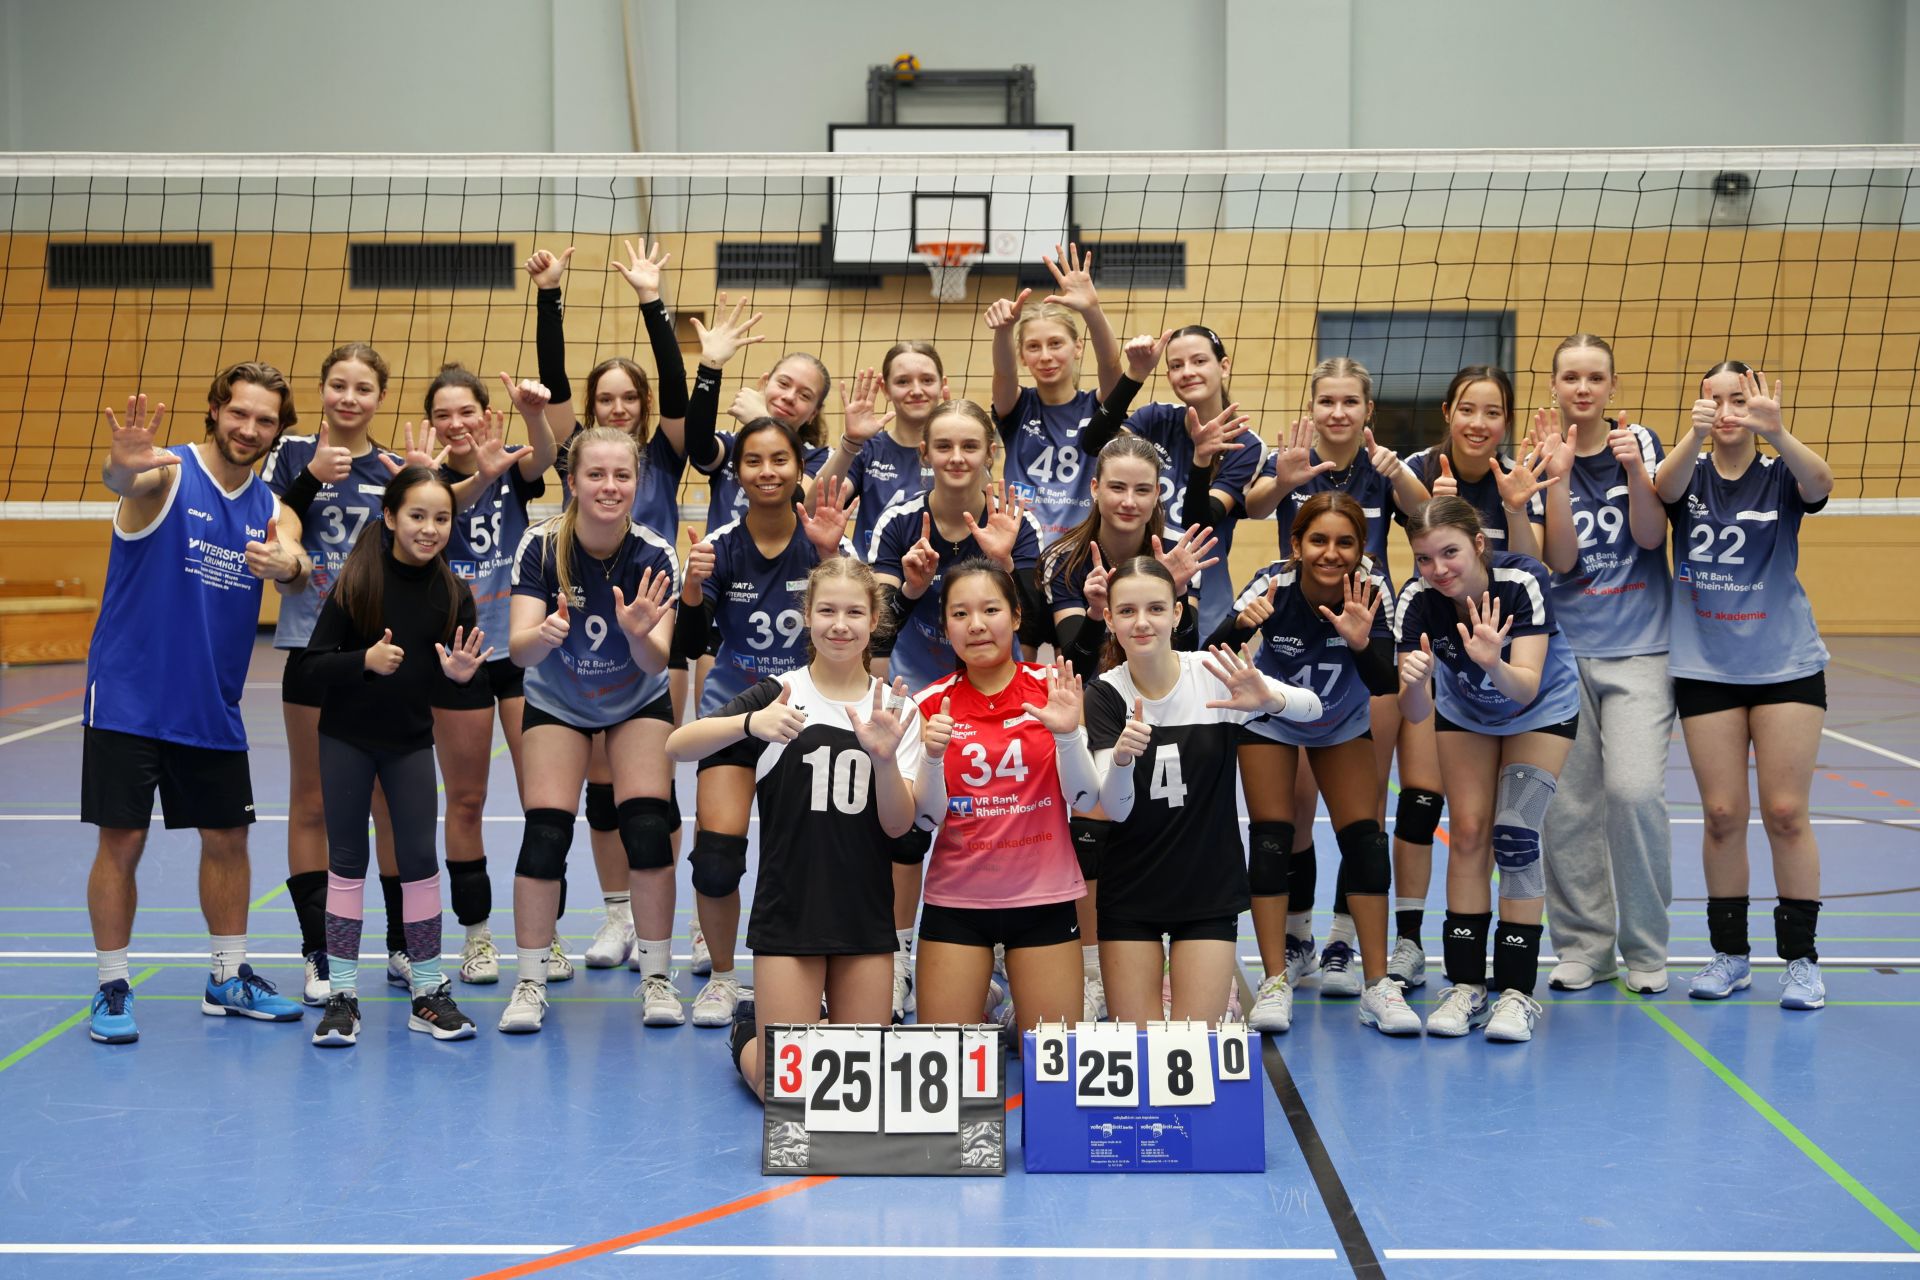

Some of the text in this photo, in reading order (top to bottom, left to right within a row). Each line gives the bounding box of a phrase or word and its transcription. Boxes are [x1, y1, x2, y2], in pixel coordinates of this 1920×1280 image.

[1027, 445, 1080, 483] 48
[1079, 498, 1090, 508] eG
[320, 505, 370, 544] 37
[1573, 505, 1624, 548] 29
[326, 551, 340, 560] VR
[1688, 523, 1746, 565] 22
[1583, 551, 1618, 566] VR Bank
[1695, 571, 1734, 582] VR Bank
[1752, 581, 1764, 591] eG
[1714, 610, 1768, 622] akademie
[584, 614, 608, 652] 9
[746, 609, 804, 651] 39
[1272, 635, 1299, 645] CRAFT
[577, 659, 615, 668] VR Bank
[757, 656, 795, 665] VR Bank
[1289, 662, 1343, 697] 47
[960, 738, 1029, 788] 34
[1150, 742, 1188, 809] 4
[802, 745, 872, 815] 10
[975, 794, 1018, 806] VR Bank
[1038, 797, 1052, 807] eG
[996, 831, 1053, 849] akademie
[779, 1043, 986, 1114] 3 25 18 1
[1042, 1037, 1245, 1098] 3 25 8 0
